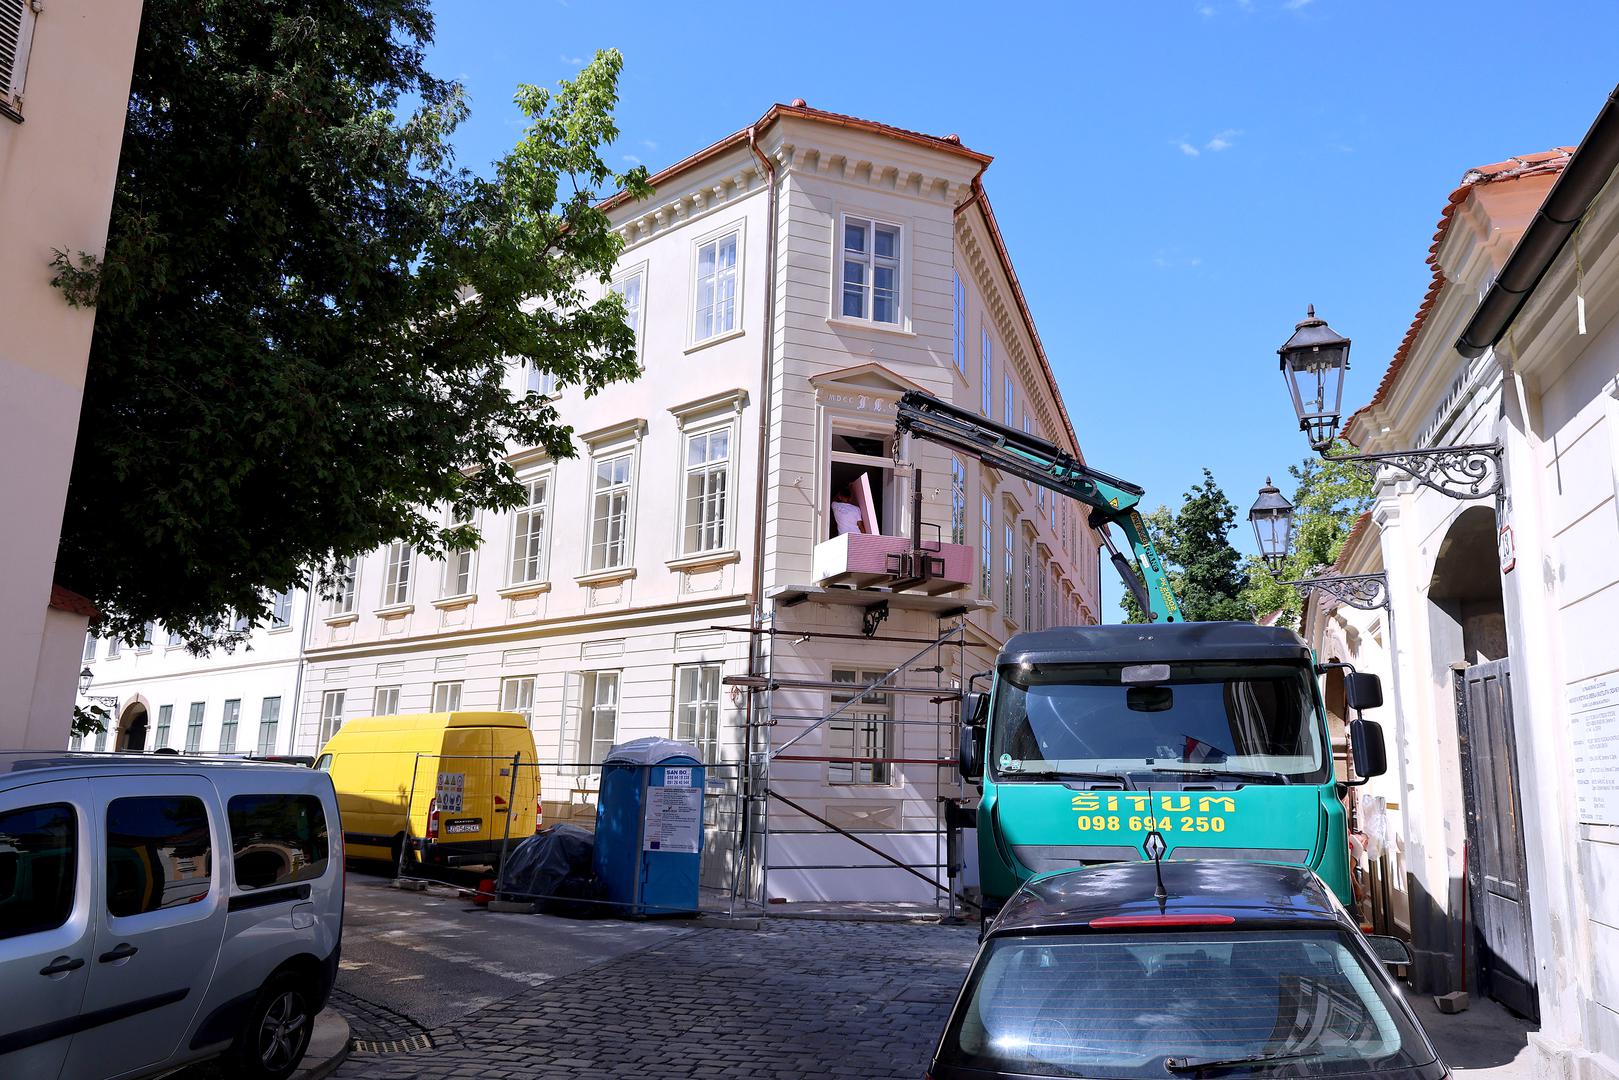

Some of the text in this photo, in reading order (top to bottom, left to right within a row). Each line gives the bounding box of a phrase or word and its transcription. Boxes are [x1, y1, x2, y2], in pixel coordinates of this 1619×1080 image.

[1502, 533, 1510, 557] 13
[1071, 792, 1236, 813] ŠITUM
[1077, 816, 1226, 832] 098 694 250
